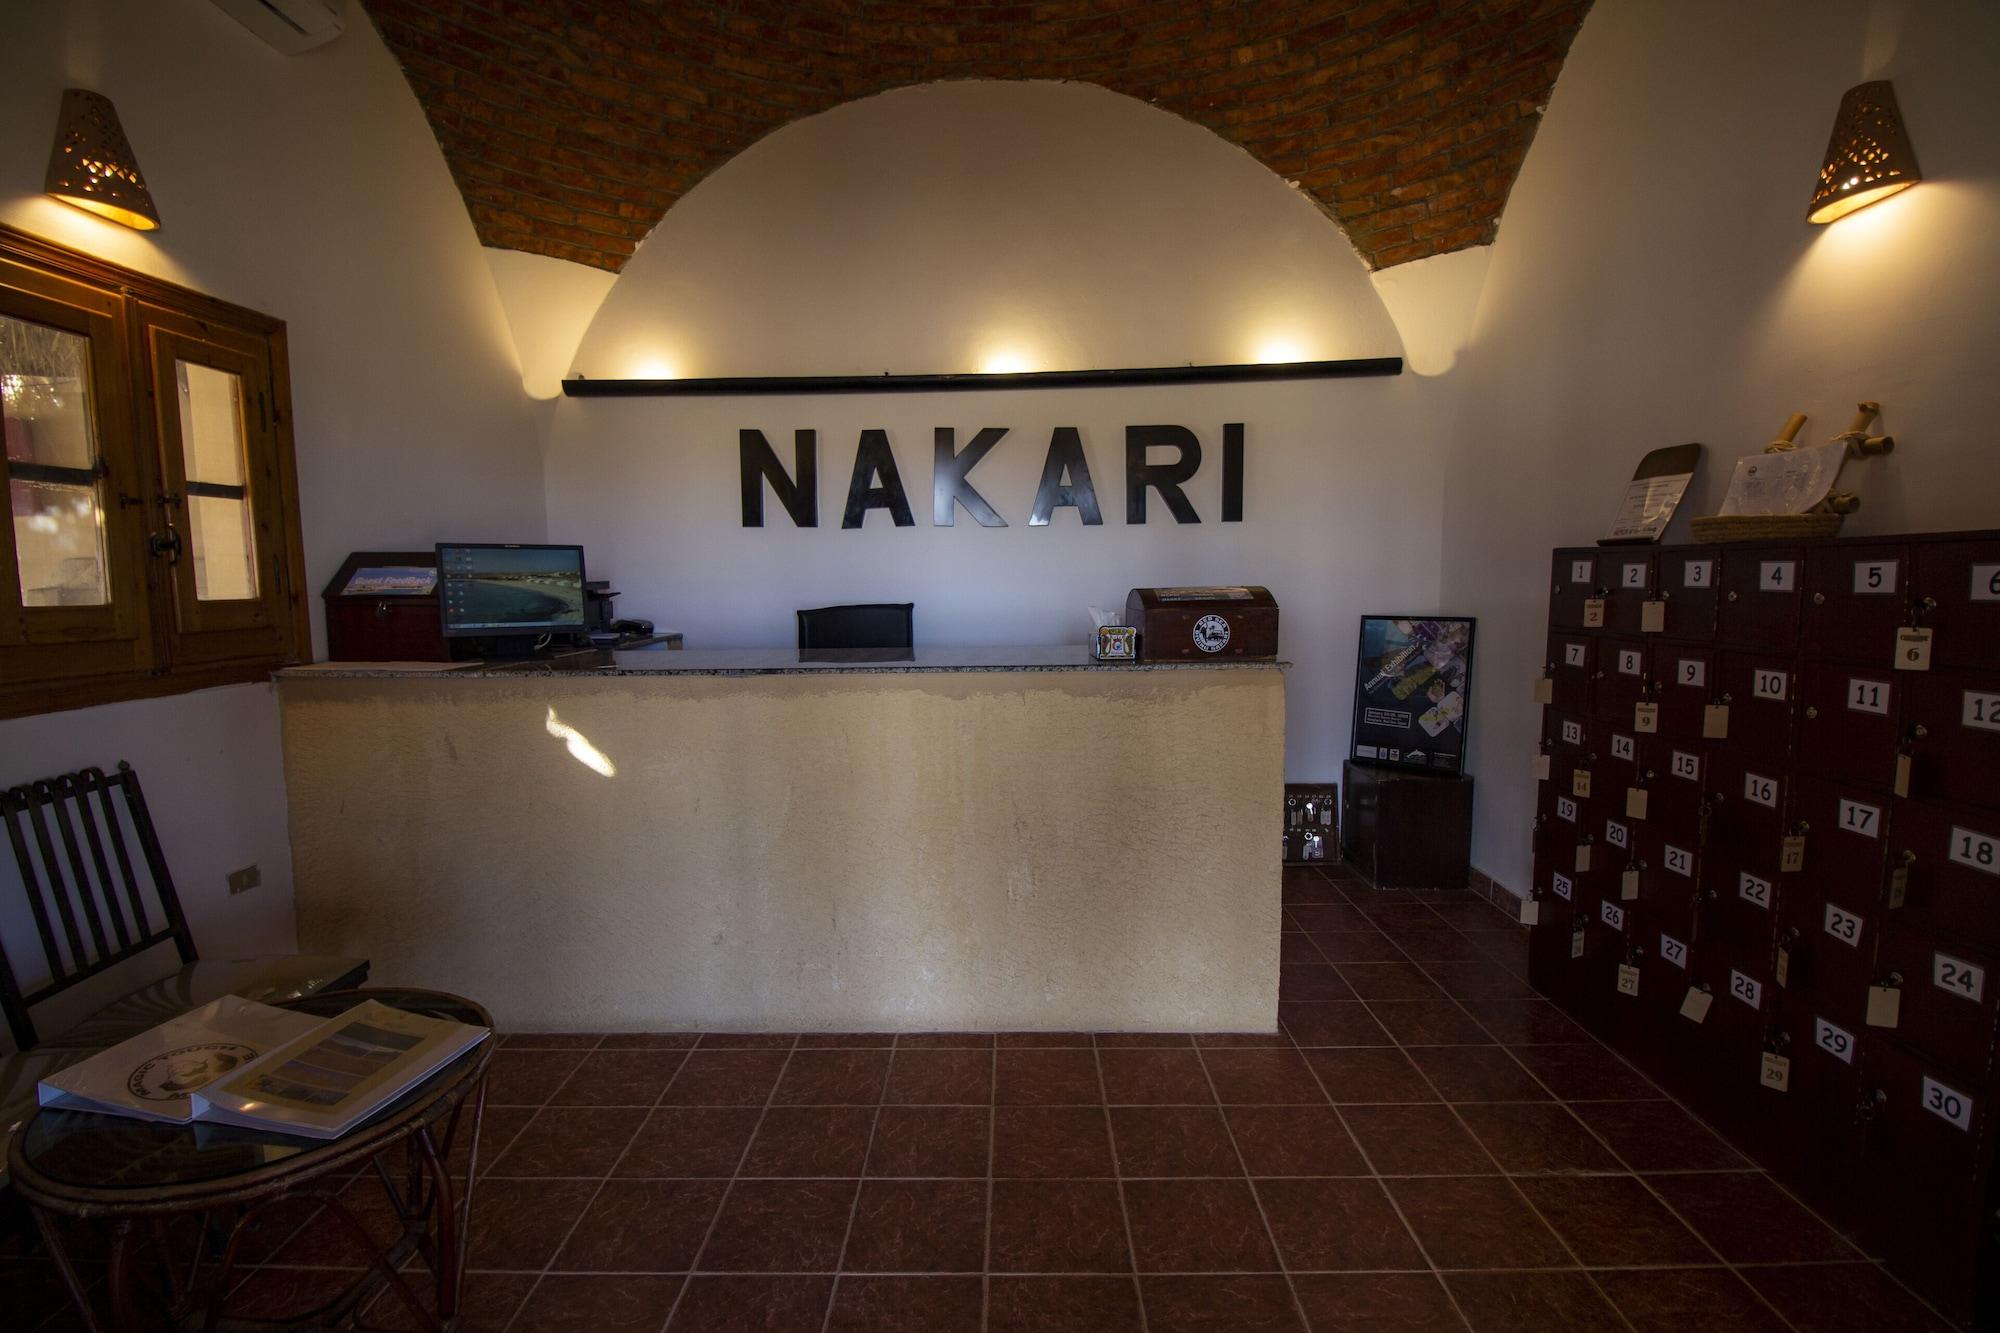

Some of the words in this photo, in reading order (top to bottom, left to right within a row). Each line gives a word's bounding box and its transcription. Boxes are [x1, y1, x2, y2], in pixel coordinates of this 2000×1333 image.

[739, 422, 1245, 529] NAKARI
[1578, 564, 1584, 579] 1
[1629, 567, 1638, 584] 2
[1693, 565, 1702, 583] 3
[1770, 566, 1783, 586] 4
[1867, 566, 1883, 589] 5
[1988, 570, 2000, 596] 6
[1590, 612, 1598, 622] 2
[1385, 644, 1416, 672] Exhibition
[1571, 647, 1580, 662] 7
[1625, 654, 1634, 671] 8
[1906, 648, 1919, 661] 6
[1686, 664, 1696, 682] 9
[1760, 674, 1782, 695] 10
[1855, 684, 1879, 708] 11
[1642, 716, 1650, 727] 9
[1972, 698, 2000, 724] 12
[1565, 724, 1578, 741] 13
[1615, 738, 1631, 756] 14
[1676, 755, 1695, 776] 15
[1751, 779, 1772, 801] 16
[1561, 801, 1574, 817] 19
[1847, 805, 1874, 830] 17
[1609, 824, 1624, 843] 20
[1668, 850, 1686, 871] 21
[1786, 852, 1799, 865] 17
[1960, 836, 1994, 866] 18
[1555, 878, 1569, 896] 25
[1744, 878, 1766, 902] 22
[1605, 905, 1620, 925] 26
[1830, 912, 1856, 939] 23
[1665, 940, 1684, 961] 27
[1622, 976, 1635, 990] 27
[1941, 962, 1975, 993] 24
[1734, 976, 1755, 1001] 28
[1821, 1026, 1848, 1054] 29
[132, 1062, 156, 1097] MAGIC
[1766, 1068, 1783, 1082] 29
[1928, 1086, 1962, 1120] 30
